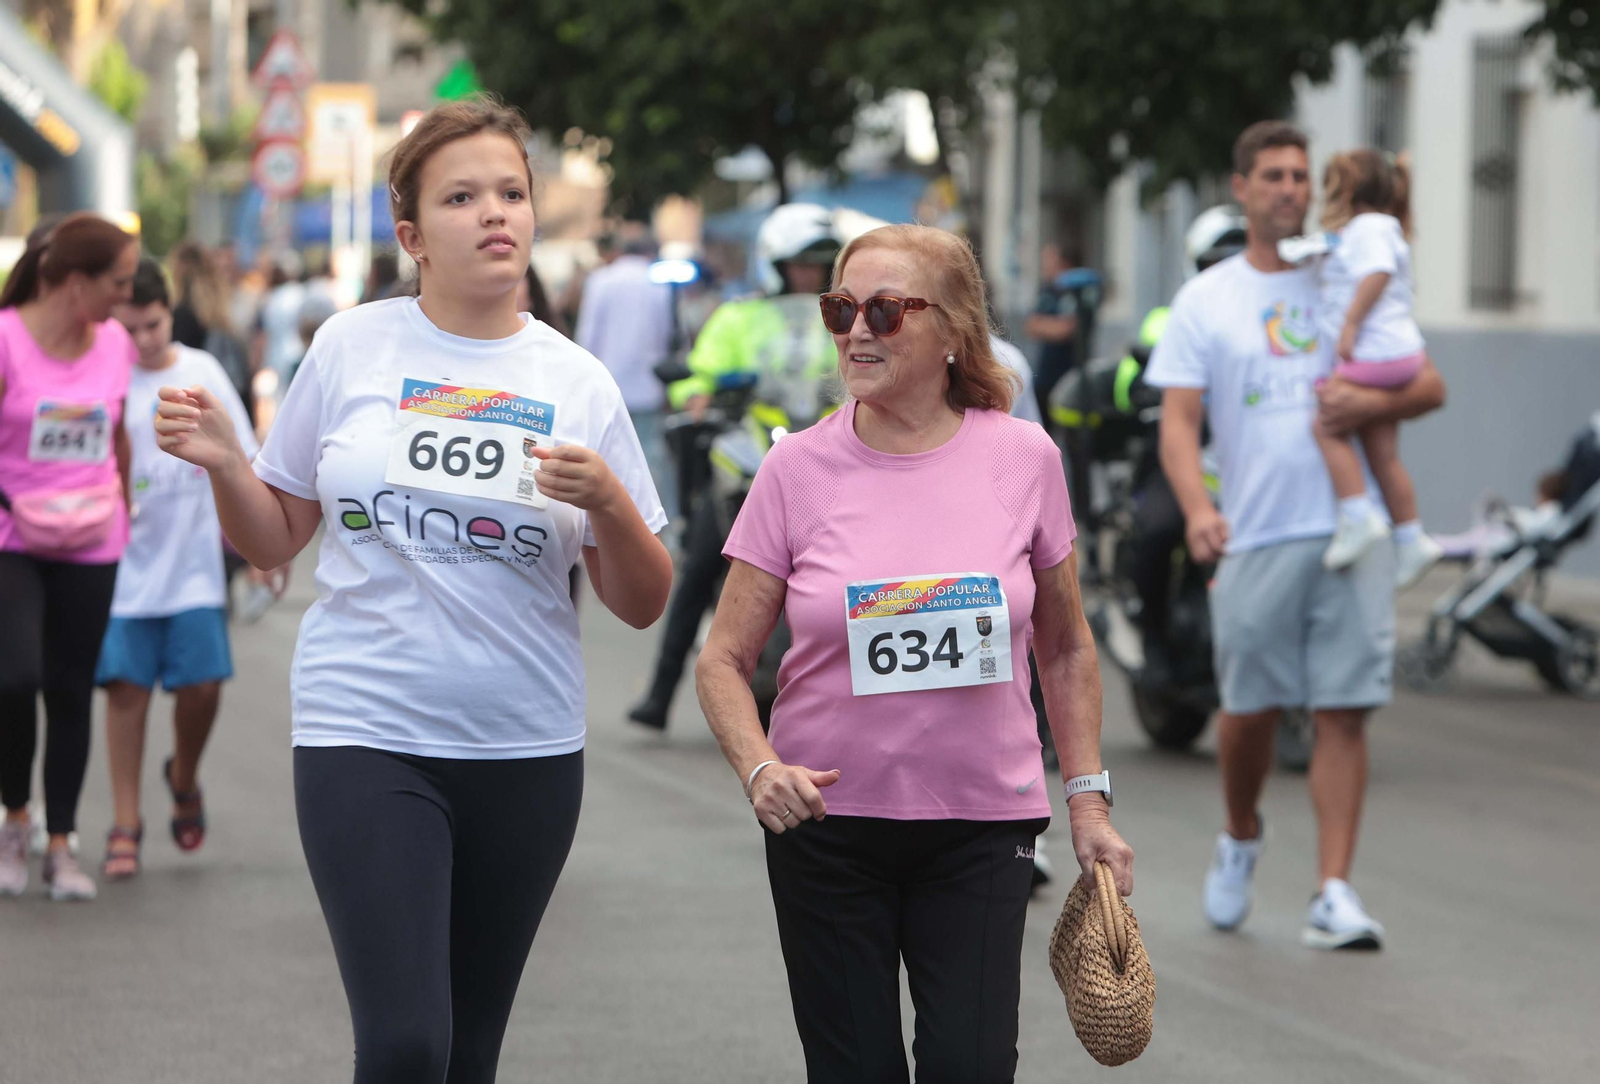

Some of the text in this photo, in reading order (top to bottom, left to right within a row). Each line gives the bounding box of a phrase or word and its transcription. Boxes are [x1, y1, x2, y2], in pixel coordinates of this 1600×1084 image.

[412, 387, 545, 418] CARRERA POPULAR
[478, 410, 514, 422] SANTO
[516, 416, 548, 432] ANGEL
[408, 430, 505, 480] 669
[338, 490, 548, 559] afines
[398, 553, 459, 564] ECESIDADES
[400, 544, 413, 553] DE
[414, 545, 458, 555] FAMILIAS
[459, 546, 473, 554] DE
[858, 583, 990, 603] CARRERA POPULAR
[926, 598, 961, 609] SANTO
[965, 595, 998, 605] ANGEL
[868, 626, 964, 675] 634
